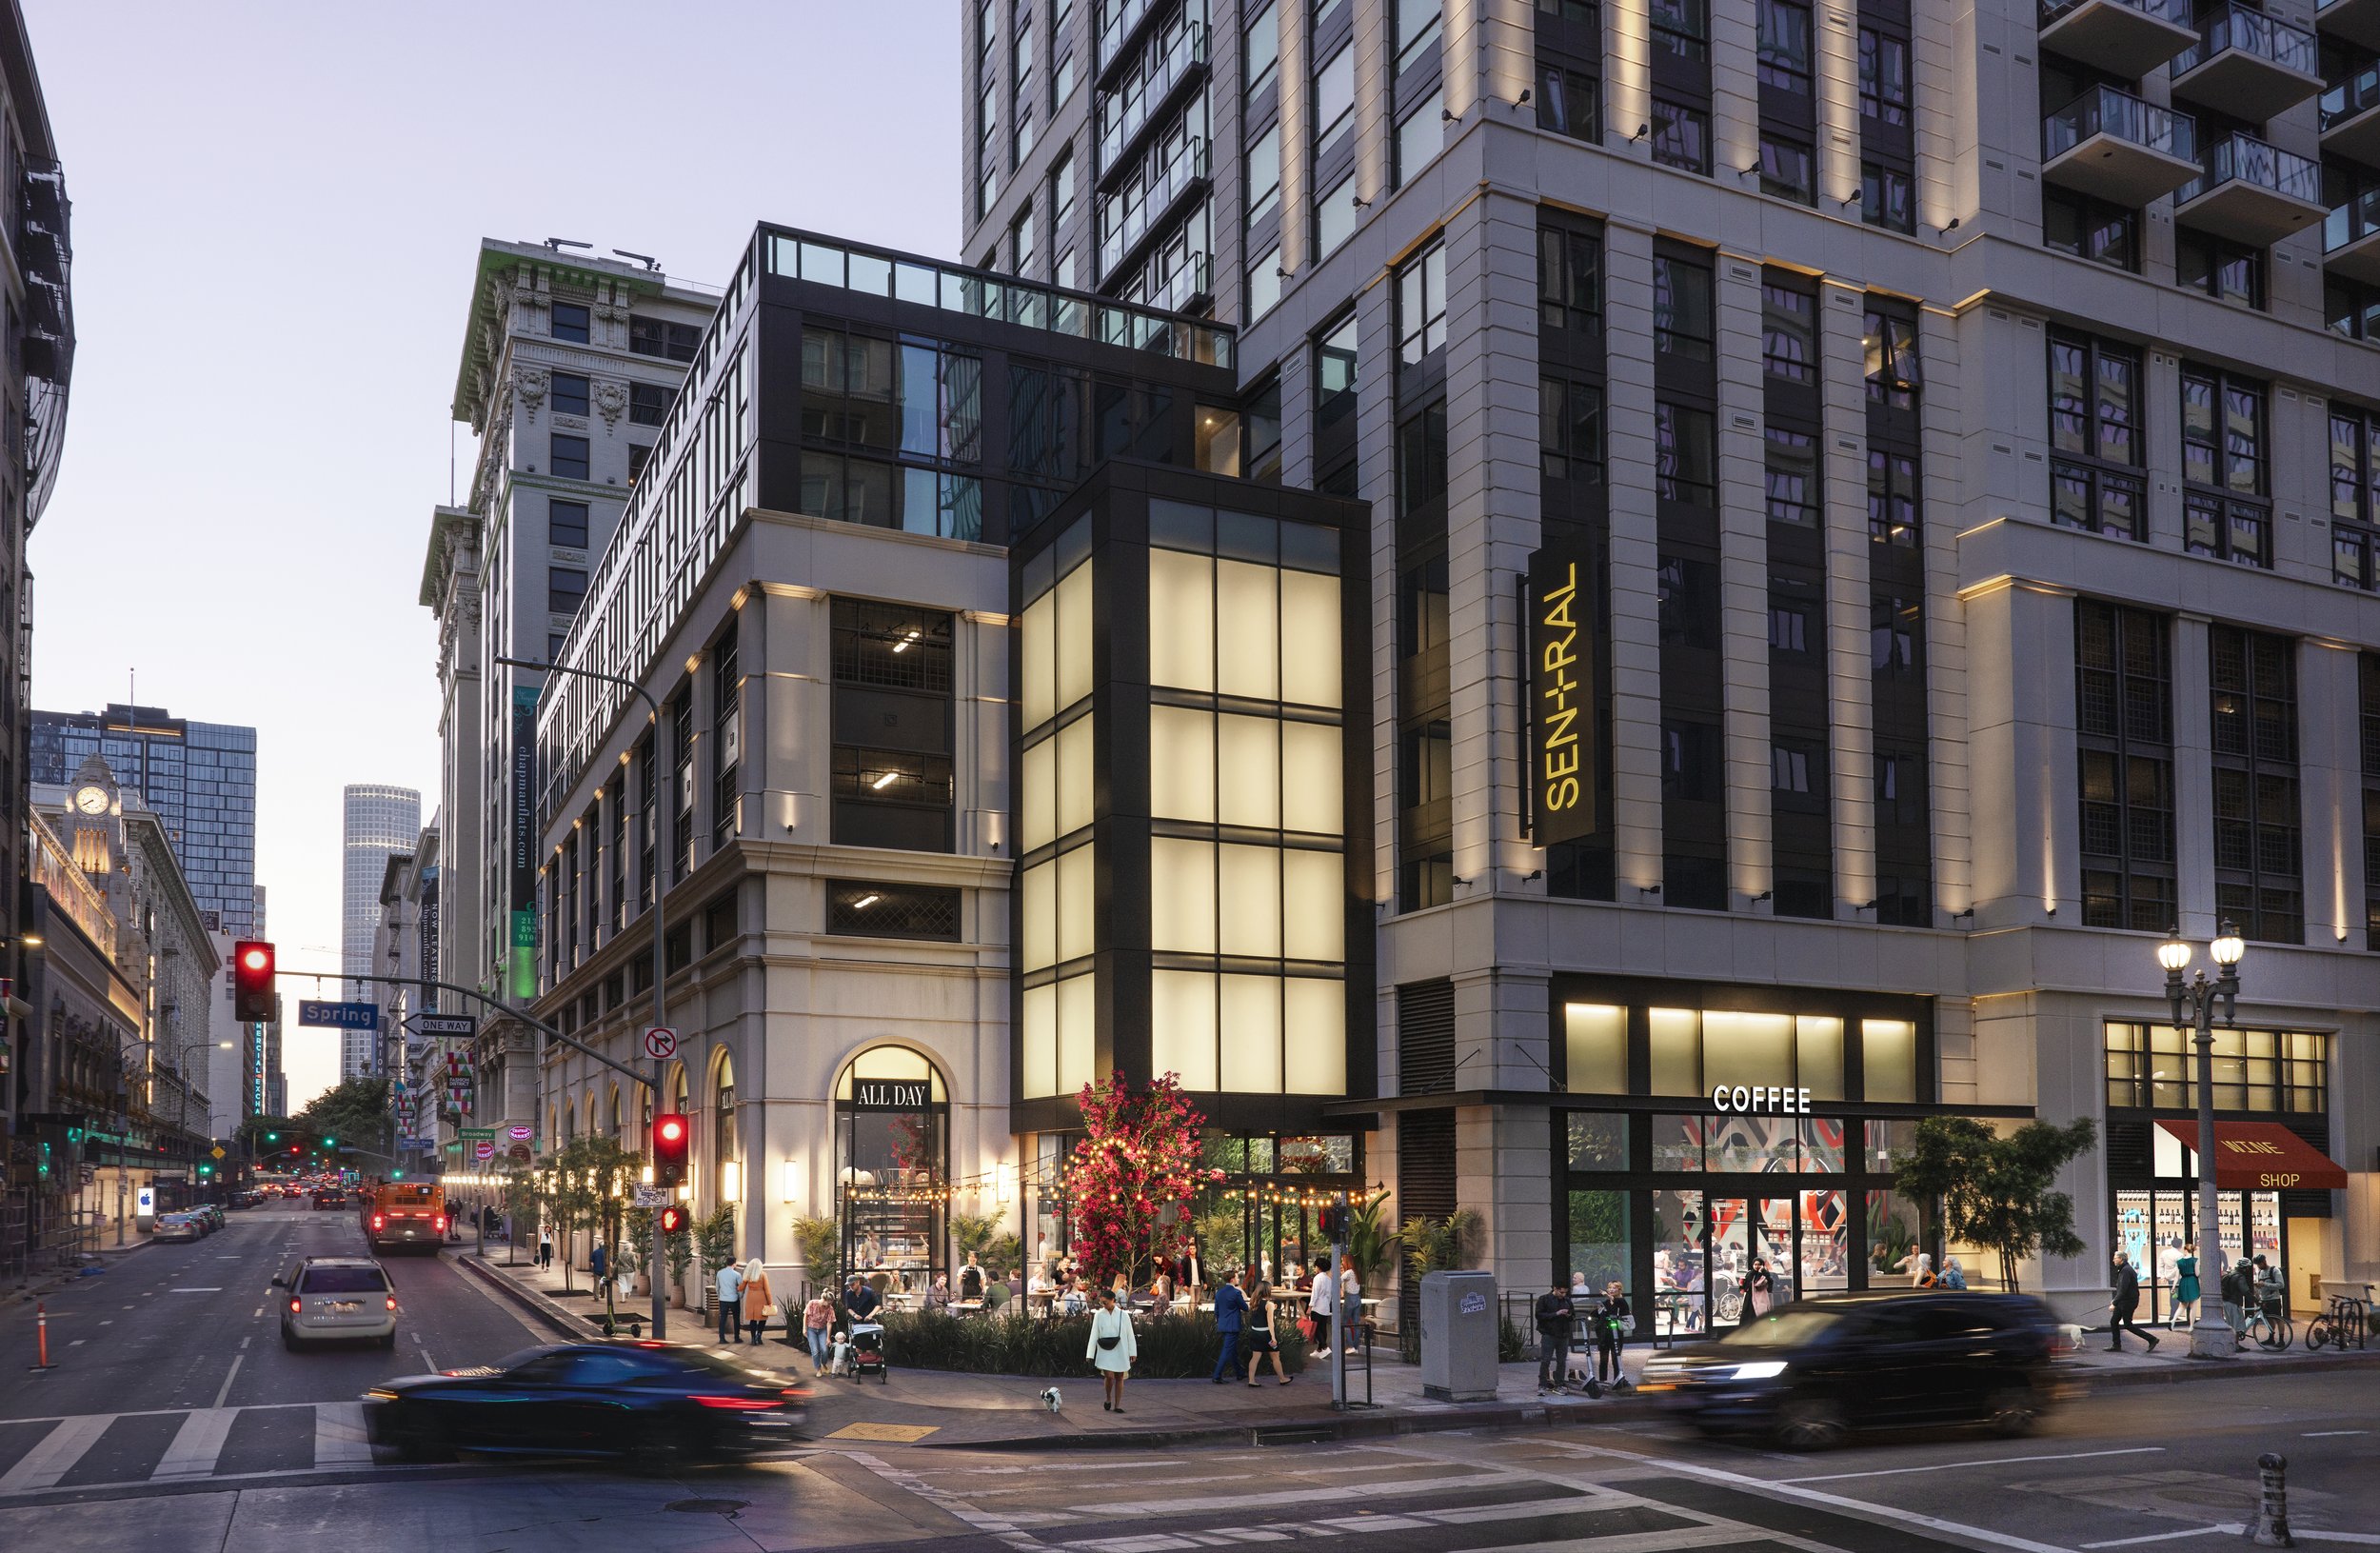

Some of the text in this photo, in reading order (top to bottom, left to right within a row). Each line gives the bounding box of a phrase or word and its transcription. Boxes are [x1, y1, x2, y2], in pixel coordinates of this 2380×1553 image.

[515, 746, 530, 868] chapmanflats.com
[307, 1005, 371, 1025] Spring
[423, 1021, 468, 1031] ONE WAY
[858, 1085, 926, 1106] ALL DAY
[1714, 1085, 1811, 1113] COFFEE
[2220, 1140, 2286, 1155] WINE
[2260, 1173, 2300, 1187] SHOP
